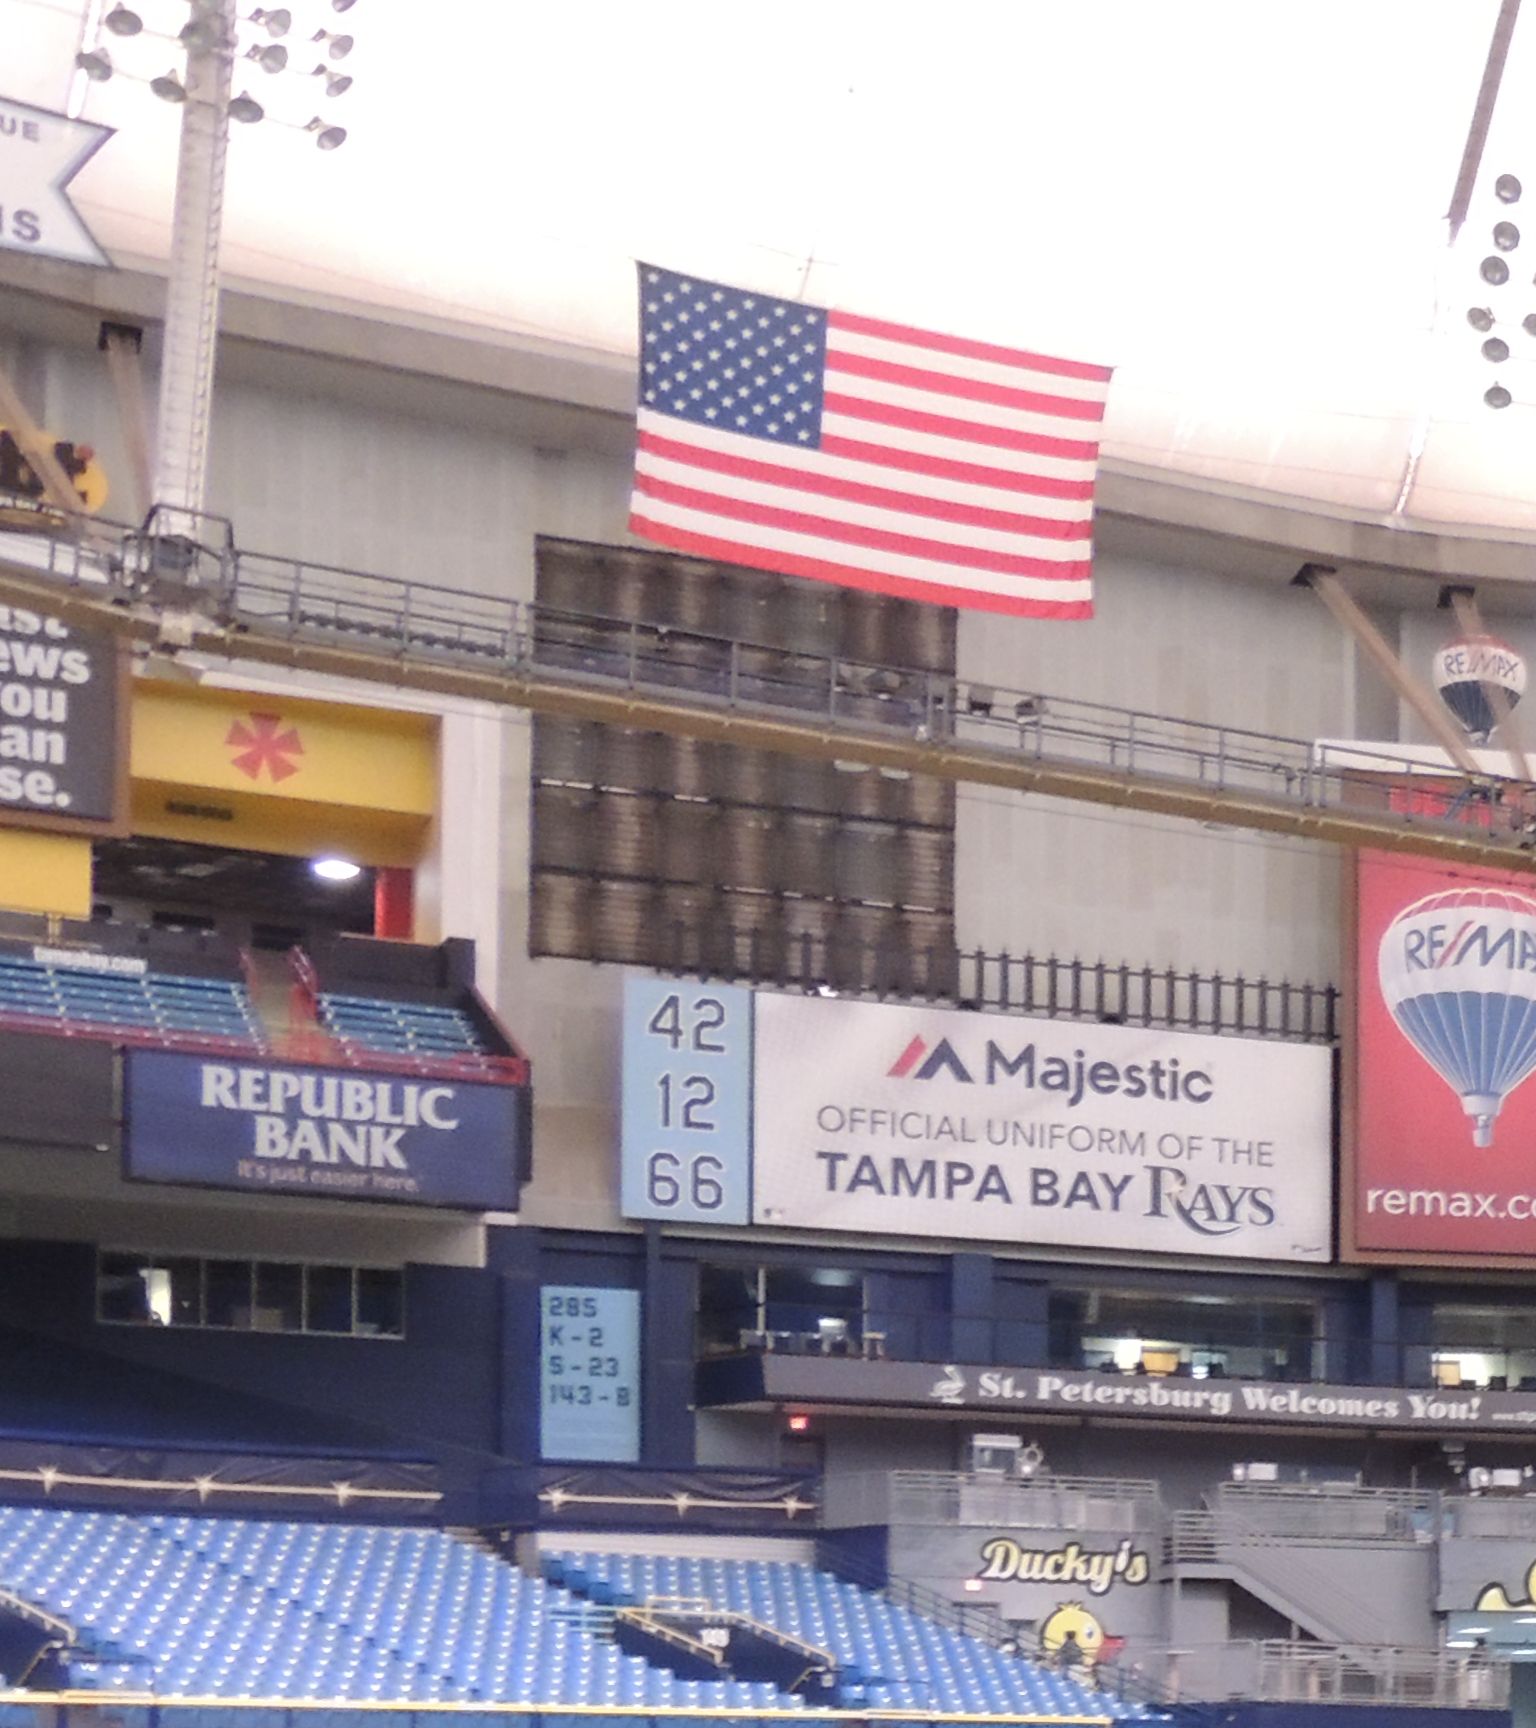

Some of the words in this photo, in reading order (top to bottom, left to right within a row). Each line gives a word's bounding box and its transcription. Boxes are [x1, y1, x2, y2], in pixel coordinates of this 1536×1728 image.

[1443, 652, 1519, 678] RE/MAX
[648, 995, 727, 1053] 42
[201, 1064, 459, 1131] REPUBLIC
[984, 1039, 1214, 1107] Majestic
[657, 1074, 717, 1132] 12
[254, 1114, 410, 1170] BANK
[816, 1104, 977, 1145] OFFICIAL
[986, 1122, 1147, 1158] UNIFORM
[1157, 1132, 1204, 1162] OF
[1211, 1137, 1276, 1168] THE
[647, 1151, 725, 1211] 66
[815, 1150, 1013, 1206] TAMPA
[1028, 1164, 1144, 1213] BAY
[549, 1296, 597, 1318] 285
[588, 1356, 619, 1377] 23
[976, 1371, 1028, 1400] St.
[1036, 1374, 1233, 1416] Petersburg
[1239, 1386, 1400, 1420] Welcomes
[1407, 1395, 1483, 1421] You!
[980, 1538, 1149, 1593] Ducky's
